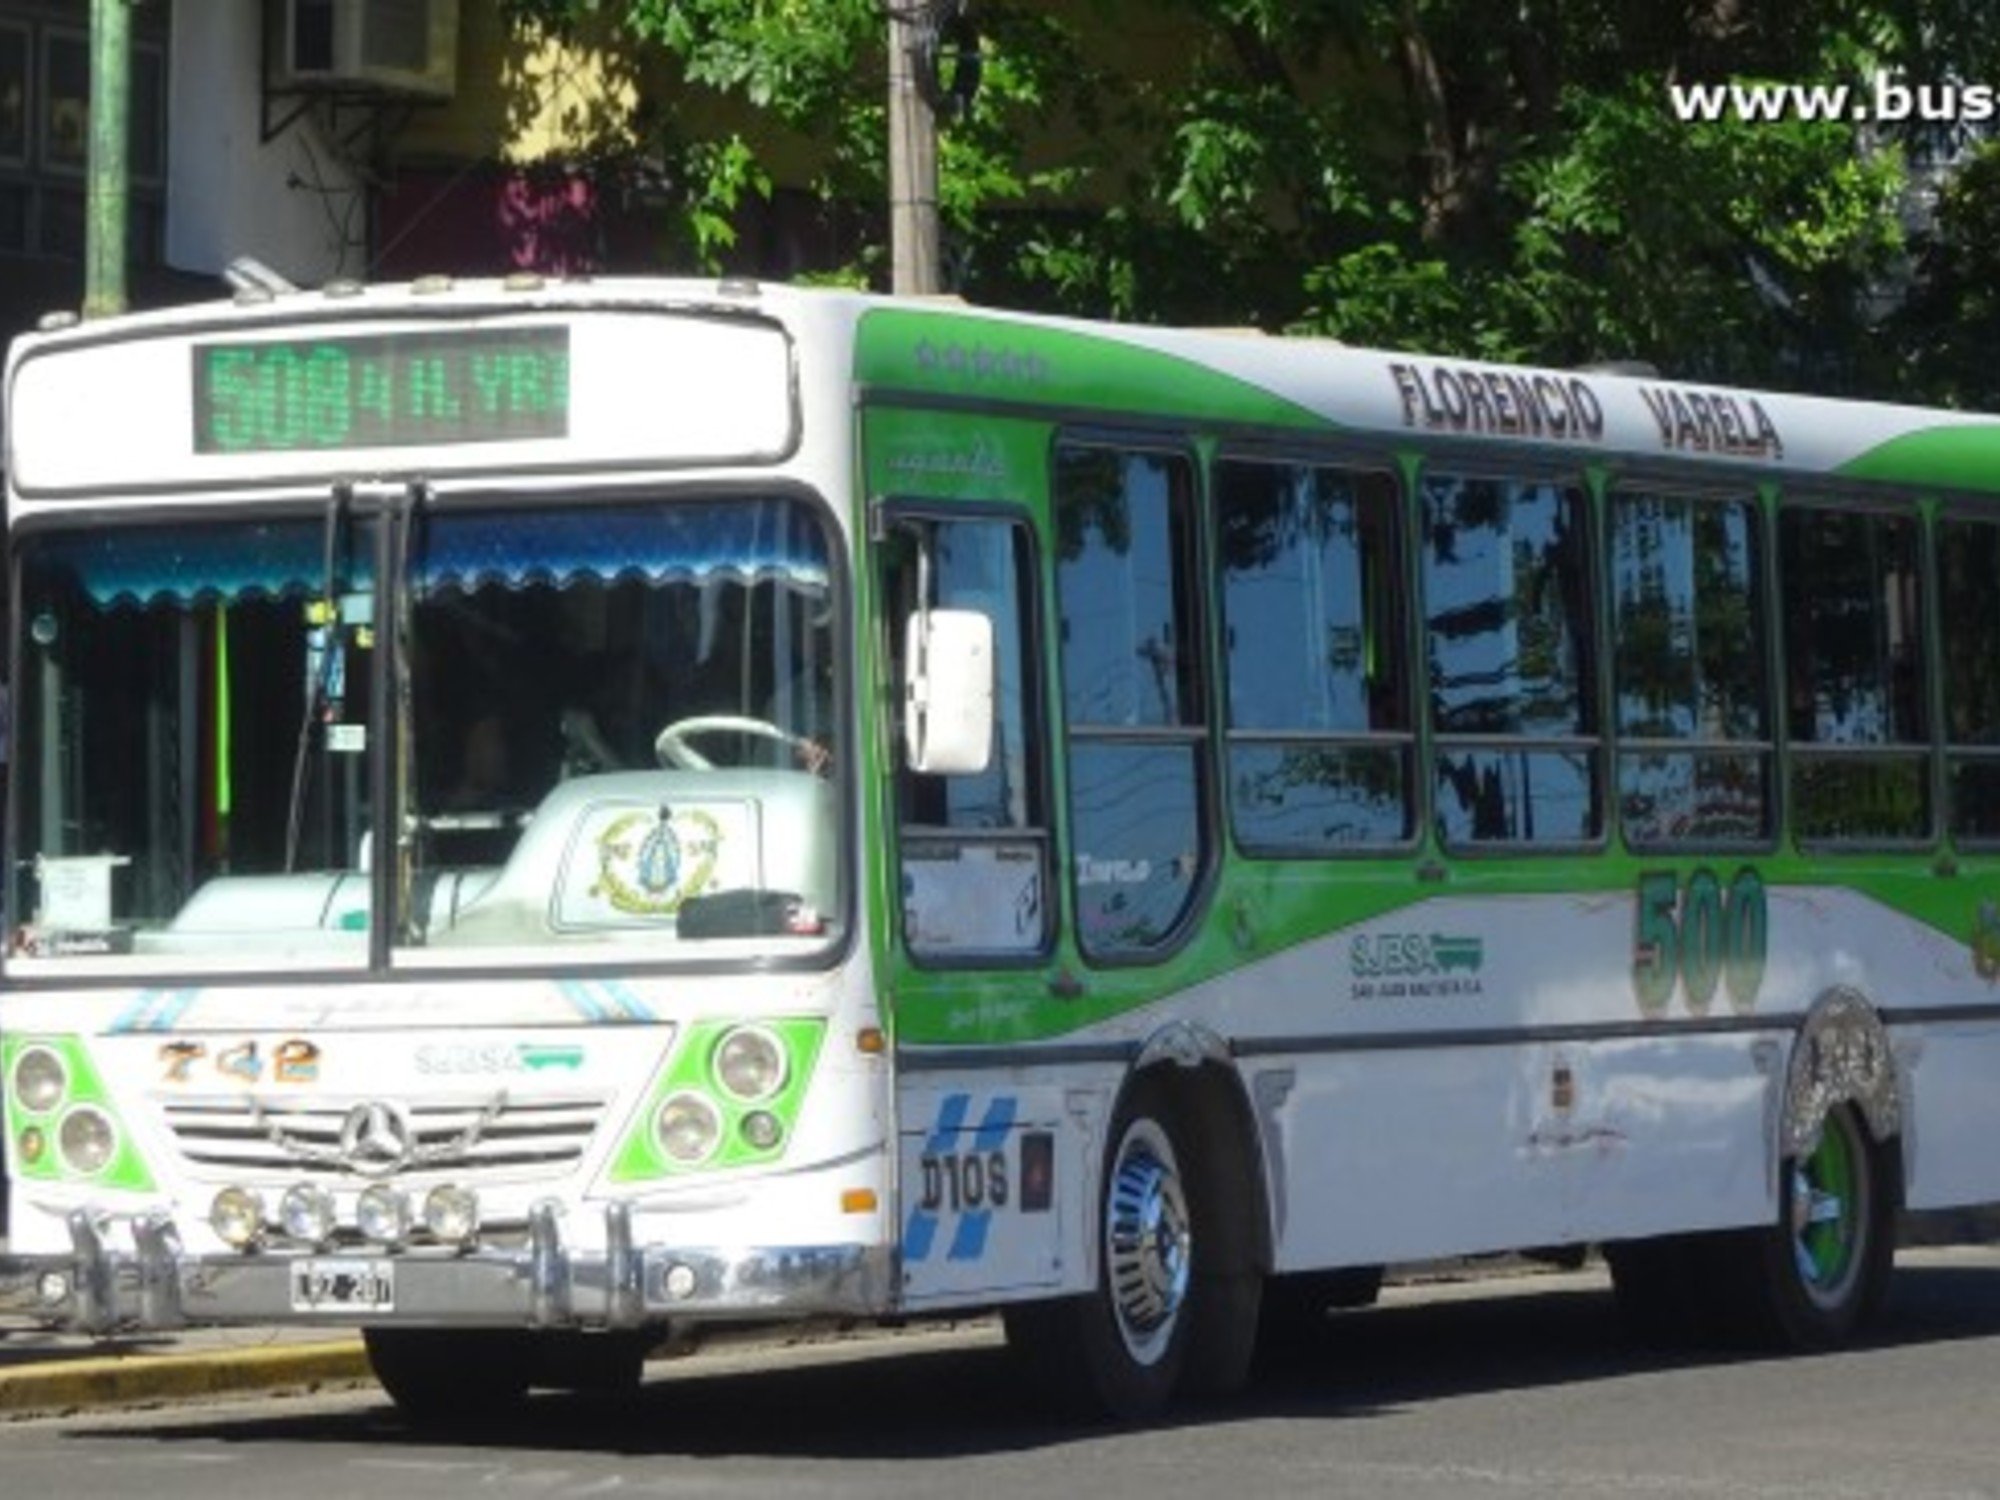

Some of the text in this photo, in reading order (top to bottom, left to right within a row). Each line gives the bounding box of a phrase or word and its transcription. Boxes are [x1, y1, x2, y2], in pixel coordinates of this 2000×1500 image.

[1389, 363, 1784, 459] FLORENCIO VARELA
[1630, 865, 1768, 1019] 500
